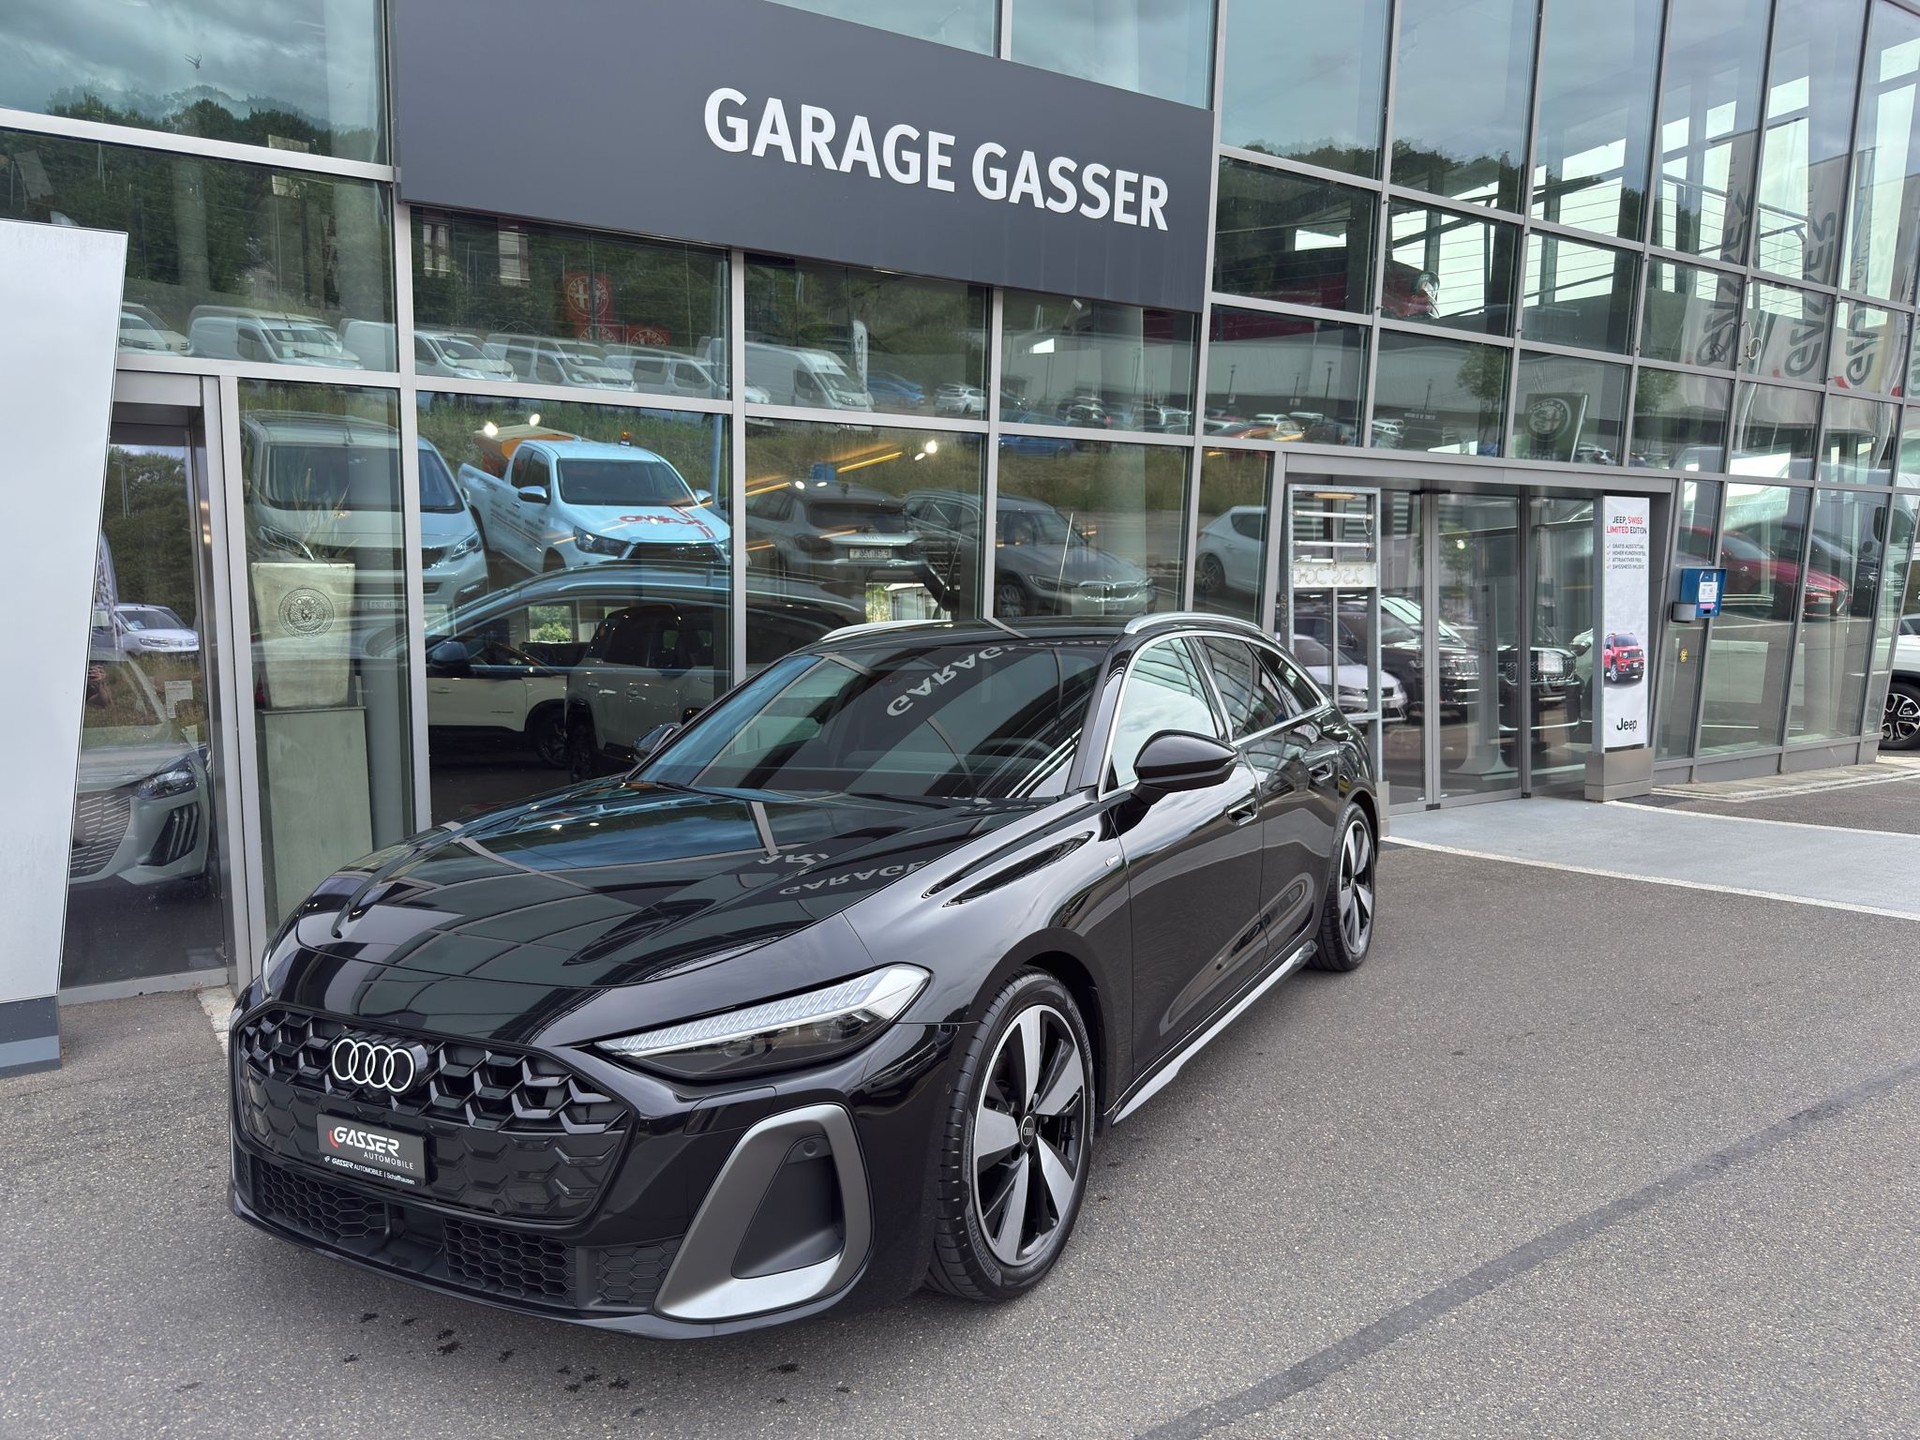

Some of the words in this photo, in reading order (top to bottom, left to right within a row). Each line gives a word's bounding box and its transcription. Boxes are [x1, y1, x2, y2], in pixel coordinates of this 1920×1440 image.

[704, 87, 956, 193] GARAGE
[972, 142, 1169, 231] GASSER
[1606, 526, 1629, 534] LIMITED
[1628, 516, 1643, 525] SWISS
[1616, 717, 1638, 732] Jeep
[333, 1126, 400, 1158] GASSER
[331, 1157, 354, 1169] GASSER
[353, 1164, 383, 1178] AUTOMOBILE
[387, 1172, 416, 1185] Schaffhausen
[363, 1151, 415, 1171] AUTOMOBILE
